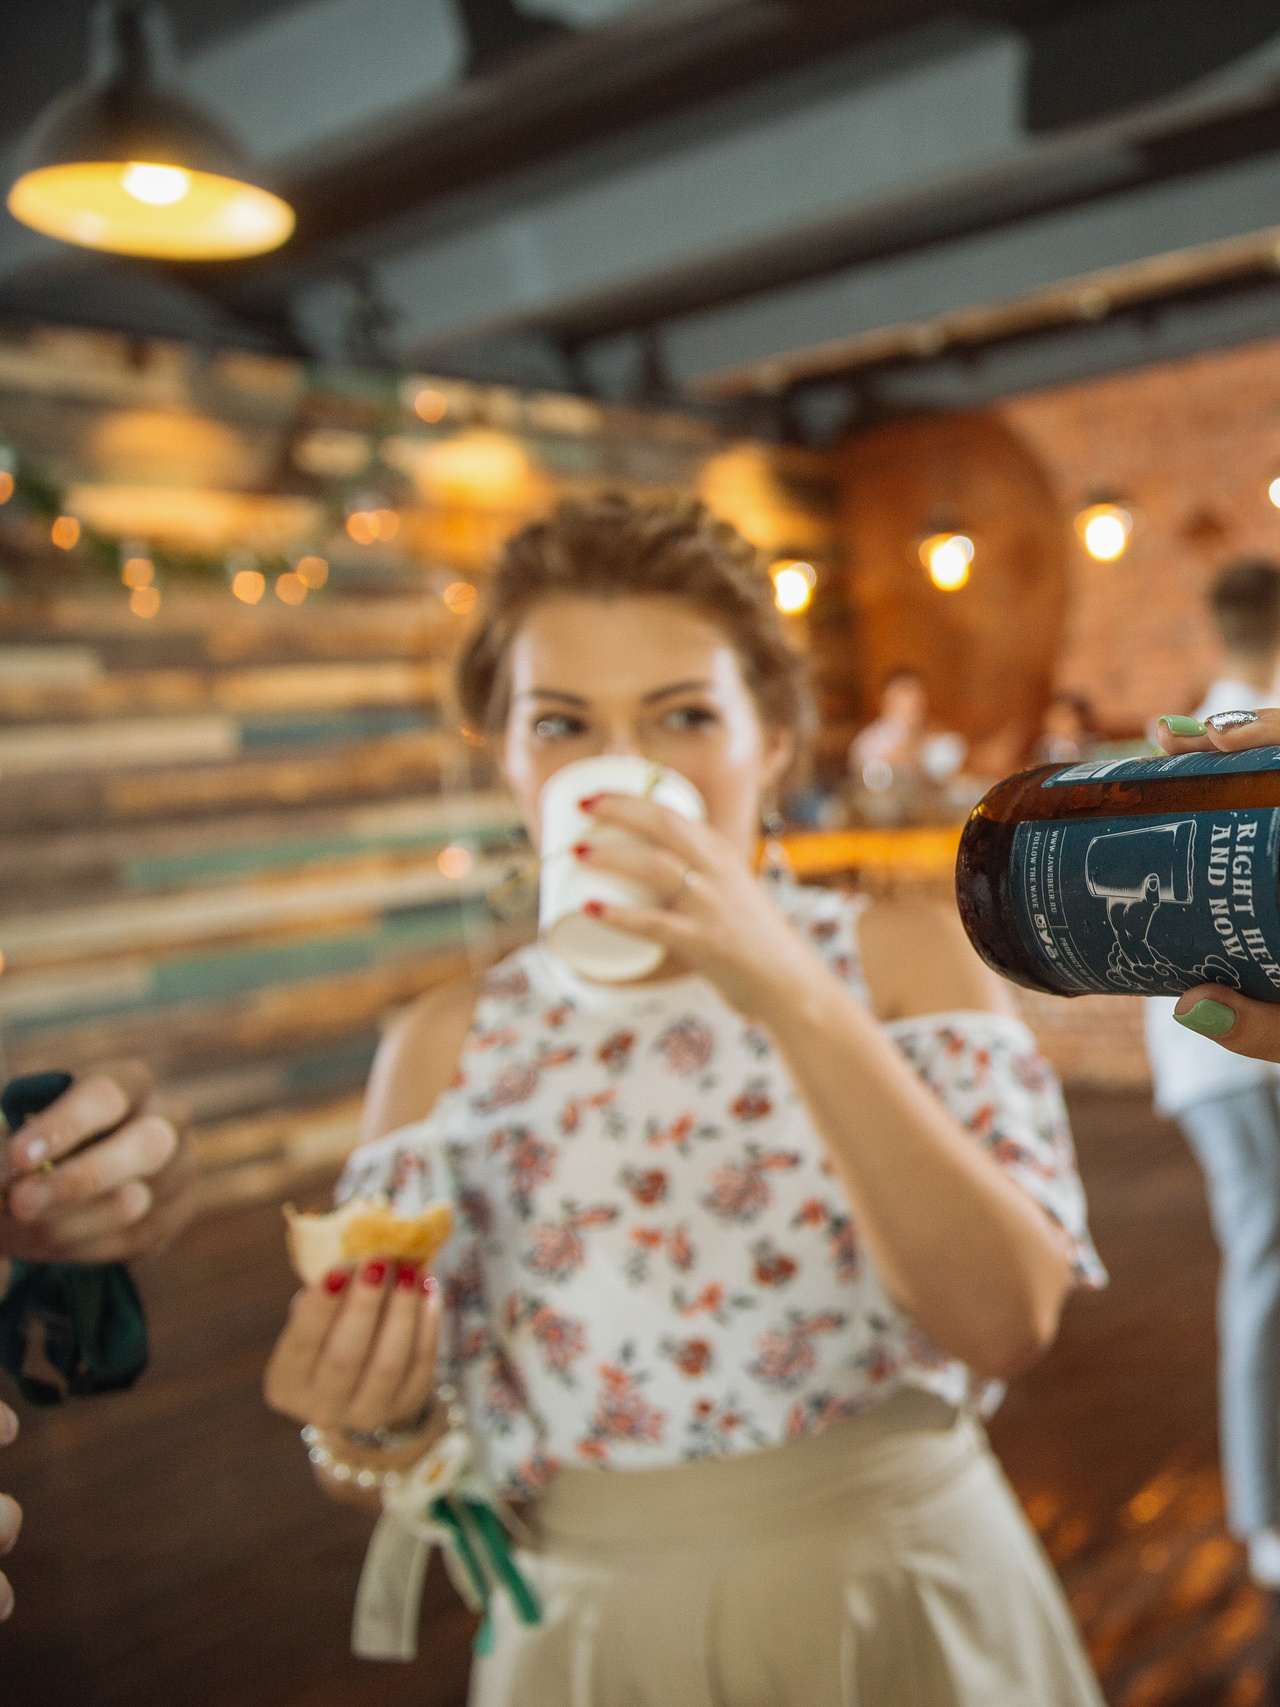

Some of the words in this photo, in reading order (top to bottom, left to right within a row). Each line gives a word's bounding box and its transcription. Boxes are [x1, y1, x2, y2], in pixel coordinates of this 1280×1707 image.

[1030, 831, 1042, 864] FOLLOW
[1207, 824, 1232, 887] AND
[1232, 820, 1258, 918] RIGHT
[1029, 866, 1037, 883] THE
[1046, 830, 1059, 914] WWW.JAWSBEER.RU
[1030, 884, 1039, 909] WAVE
[1059, 937, 1082, 969] PRODUCT
[1208, 897, 1249, 962] NOW
